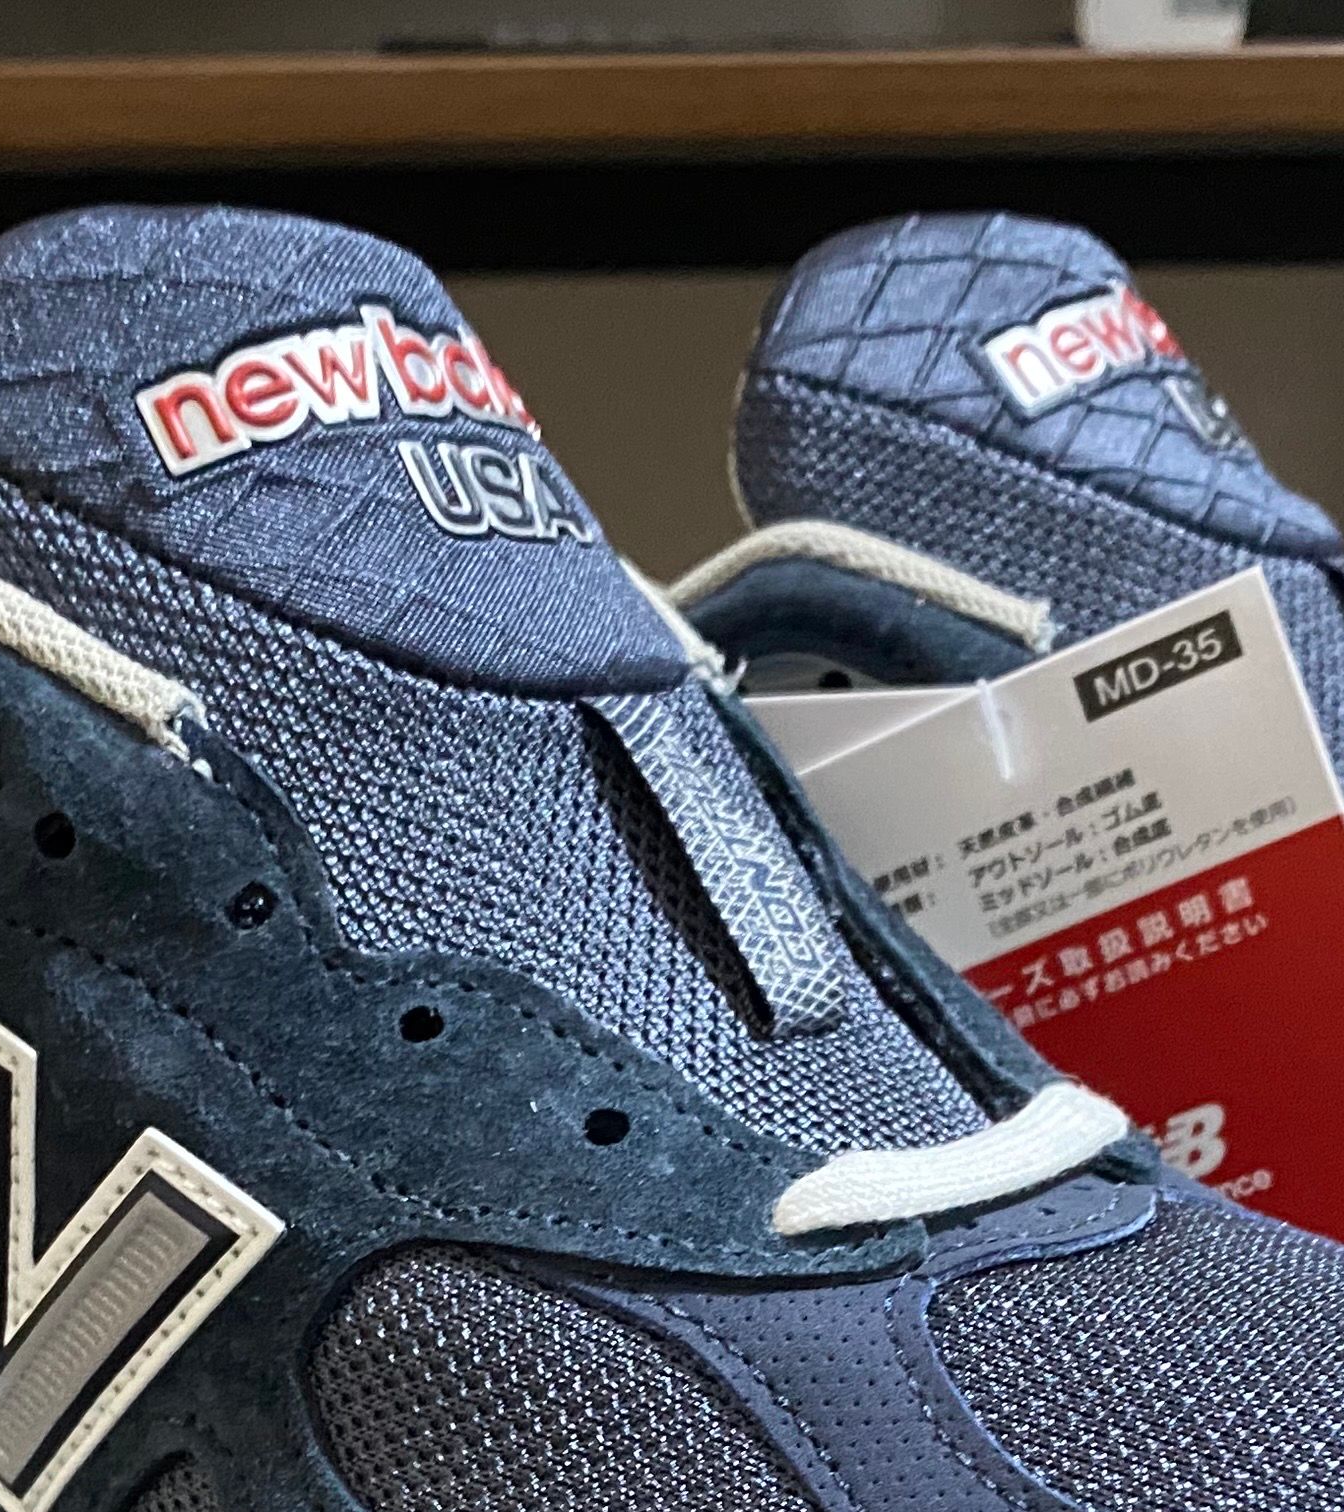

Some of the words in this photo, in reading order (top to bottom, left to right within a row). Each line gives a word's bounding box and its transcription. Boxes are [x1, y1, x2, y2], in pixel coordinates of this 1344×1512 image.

[137, 325, 379, 475] new
[398, 441, 593, 544] USA
[1093, 628, 1223, 706] MD-35
[985, 877, 1254, 1000] ーズ取扱説明書
[1144, 1103, 1226, 1179] B
